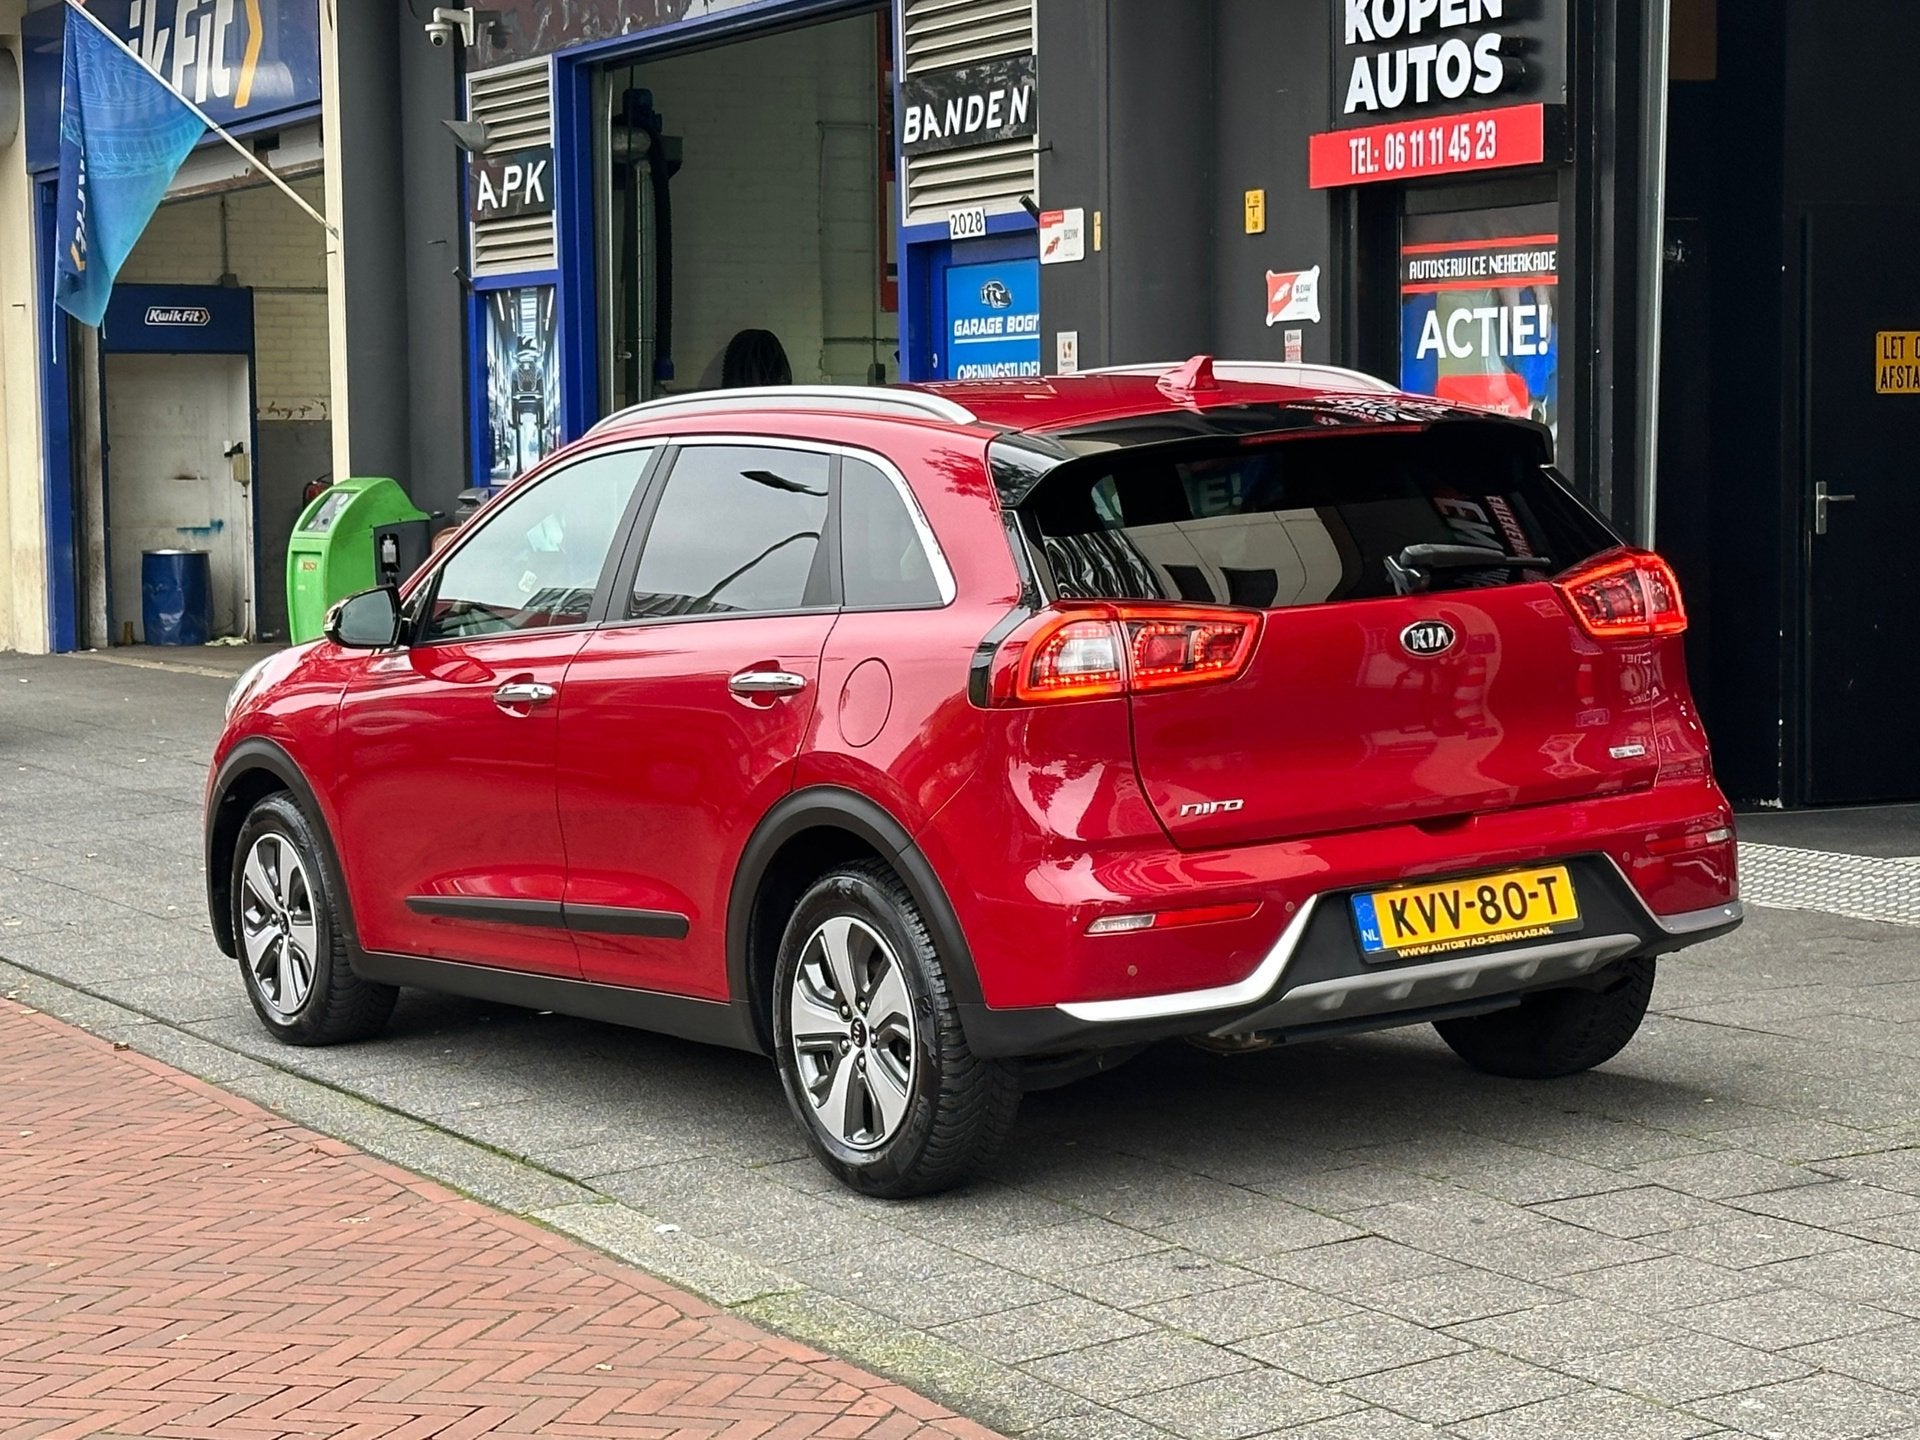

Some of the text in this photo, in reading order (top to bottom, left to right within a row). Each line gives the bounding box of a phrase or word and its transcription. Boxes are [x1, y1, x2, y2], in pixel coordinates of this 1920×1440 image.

[1344, 33, 1503, 114] AUTOS
[903, 86, 1030, 144] BANDEN
[1350, 119, 1496, 176] TEL: 06 11 11 45 23
[477, 160, 546, 212] APK
[951, 211, 984, 235] 2028
[1409, 250, 1556, 280] AUTOSERVICE NEHERKADE
[954, 313, 1040, 337] GARAGE BOGI
[1416, 304, 1549, 360] ACTIE!
[1883, 336, 1906, 359] LET
[1881, 365, 1920, 389] AFSTA
[1410, 628, 1449, 650] KIA
[1180, 799, 1244, 816] niro
[1389, 876, 1557, 938] KVV-80-T
[1363, 928, 1379, 943] NL
